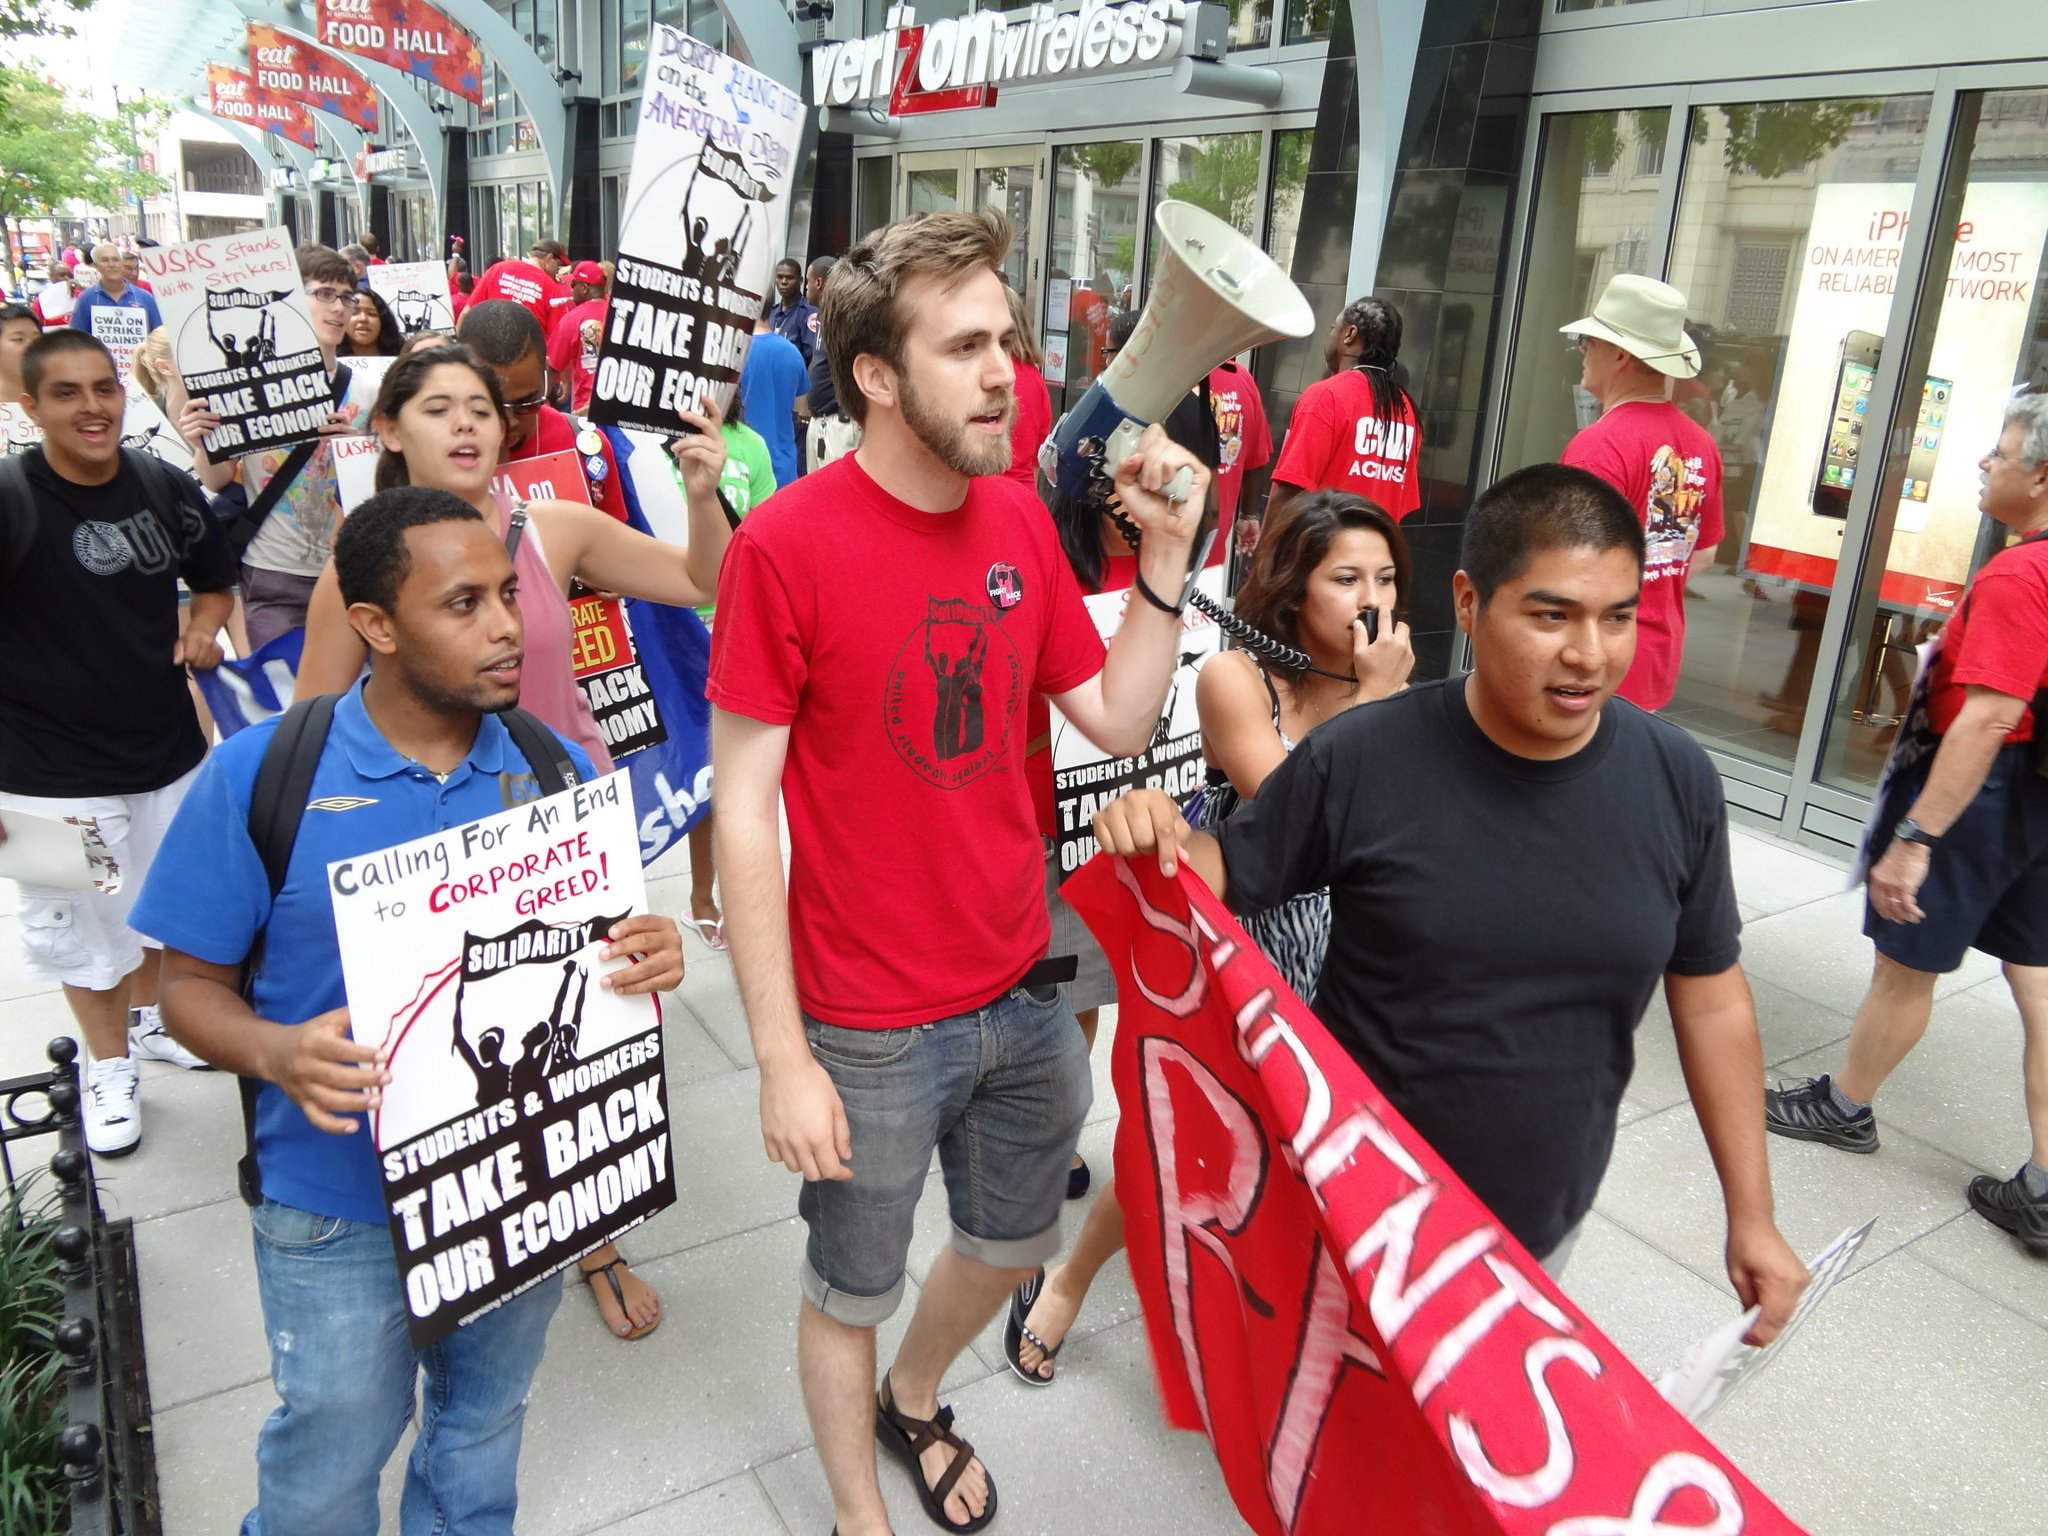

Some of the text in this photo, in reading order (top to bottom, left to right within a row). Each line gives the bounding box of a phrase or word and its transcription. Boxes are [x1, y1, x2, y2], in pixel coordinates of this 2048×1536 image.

[256, 45, 292, 64] eat
[326, 21, 448, 55] FOOD HALL
[812, 0, 1185, 117] verizon wireless
[215, 80, 246, 97] eat
[258, 70, 351, 95] FOOD HALL
[216, 101, 292, 120] FOOD HALL
[644, 91, 746, 150] AMERICAN
[145, 243, 215, 276] USAS
[616, 258, 700, 302] STUDENTS
[702, 286, 715, 306] &
[1811, 246, 2023, 273] ON AMER MOST
[208, 291, 274, 308] SOLIDARITY
[1818, 272, 2029, 302] RELIABL TWORK
[94, 316, 143, 326] CWA ON
[97, 325, 142, 335] STRIKE
[611, 297, 695, 359] TAKE
[184, 350, 322, 390] STUDENTS & WORKERS
[596, 356, 655, 408] OUR
[208, 370, 331, 417] AKE BACK
[246, 399, 335, 441] ECONOMY
[1354, 416, 1415, 462] CWA
[571, 600, 608, 627] RATE
[1925, 595, 1955, 607] verizon
[572, 625, 616, 671] EED
[588, 665, 650, 711] ACK
[890, 671, 905, 726] united
[596, 699, 659, 745] NOMY
[1056, 734, 1202, 789] STUDENTS & WORKE
[1058, 782, 1133, 832] TA
[333, 842, 450, 896] Calling
[461, 823, 511, 859] For
[528, 804, 559, 835] An
[573, 777, 619, 823] End
[374, 831, 591, 922] to CORPORATE
[515, 851, 609, 915] GREED!
[468, 922, 593, 974] SOLIDARITY
[382, 1033, 660, 1183] STUDENTS & WORKERS
[392, 1073, 666, 1251] TAKE BACK
[406, 1132, 668, 1318] OUR ECONOMY
[513, 1273, 543, 1297] student
[542, 1265, 557, 1280] and
